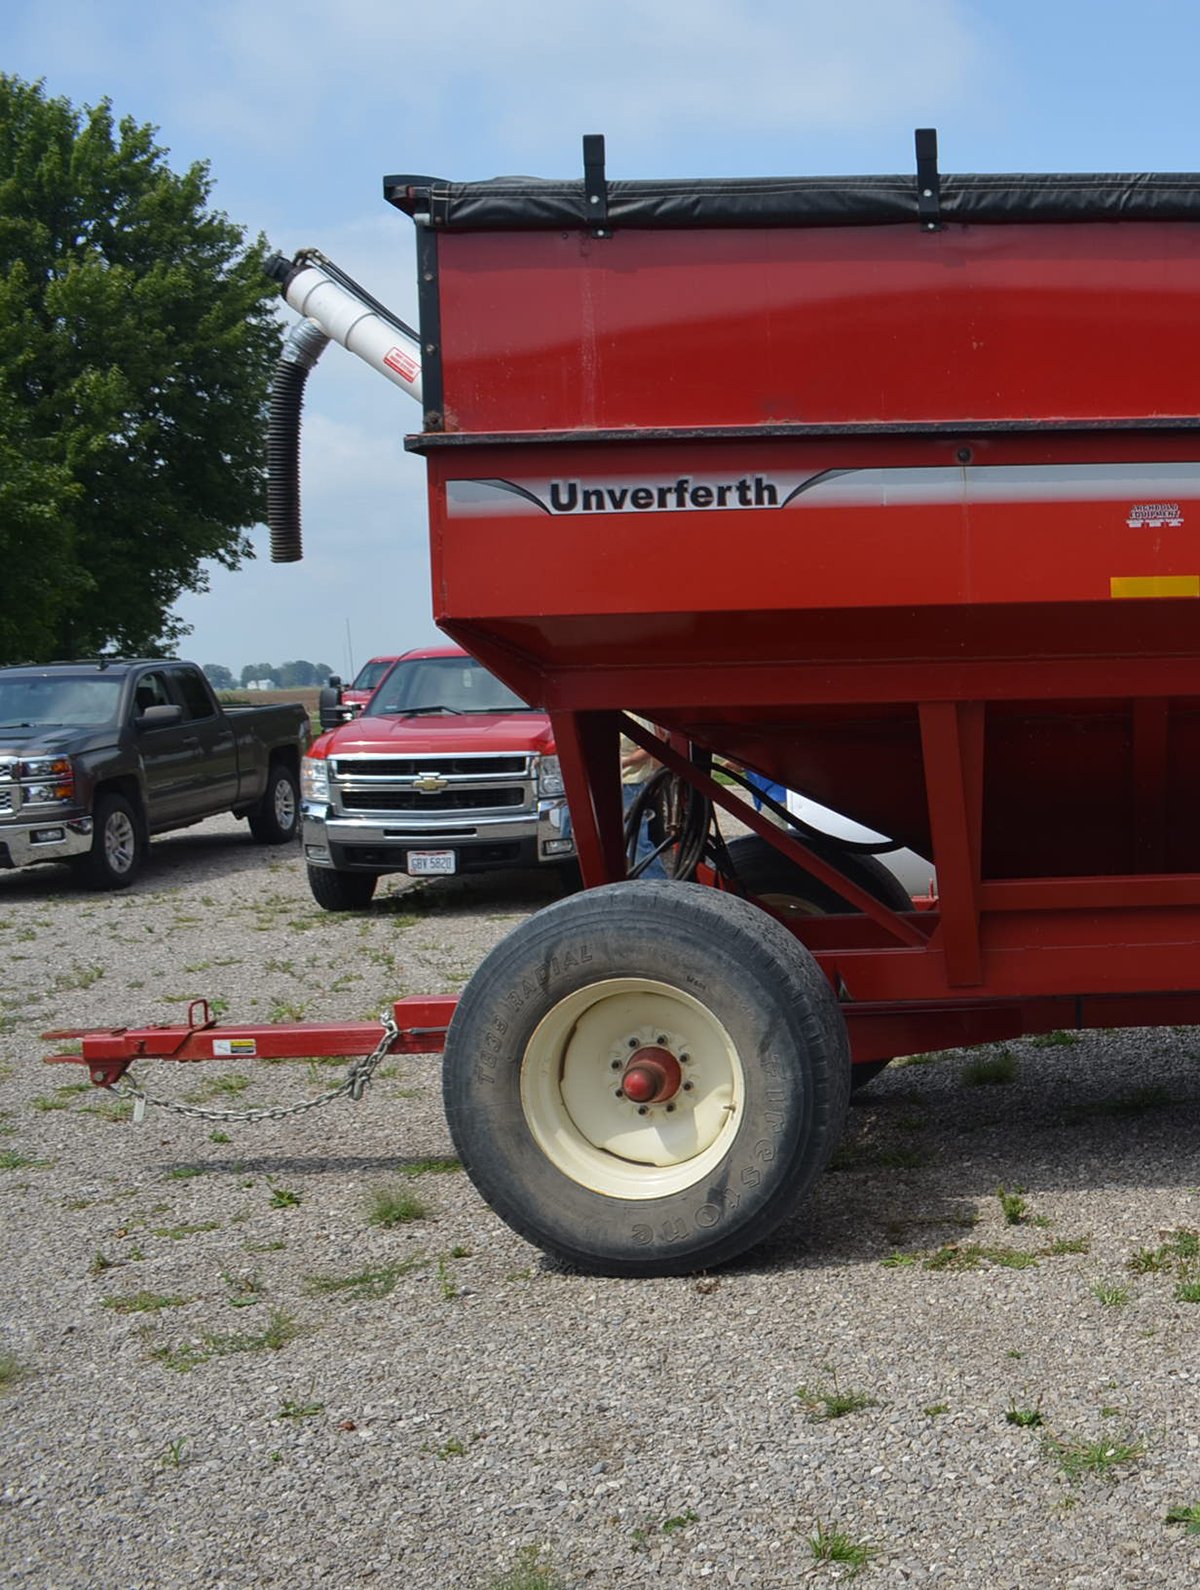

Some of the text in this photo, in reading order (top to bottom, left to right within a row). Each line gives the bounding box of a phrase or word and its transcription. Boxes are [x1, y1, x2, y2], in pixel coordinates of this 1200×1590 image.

[550, 477, 778, 512] Unverferth
[507, 945, 593, 1013] RADIAL
[631, 1053, 792, 1246] Firestone
